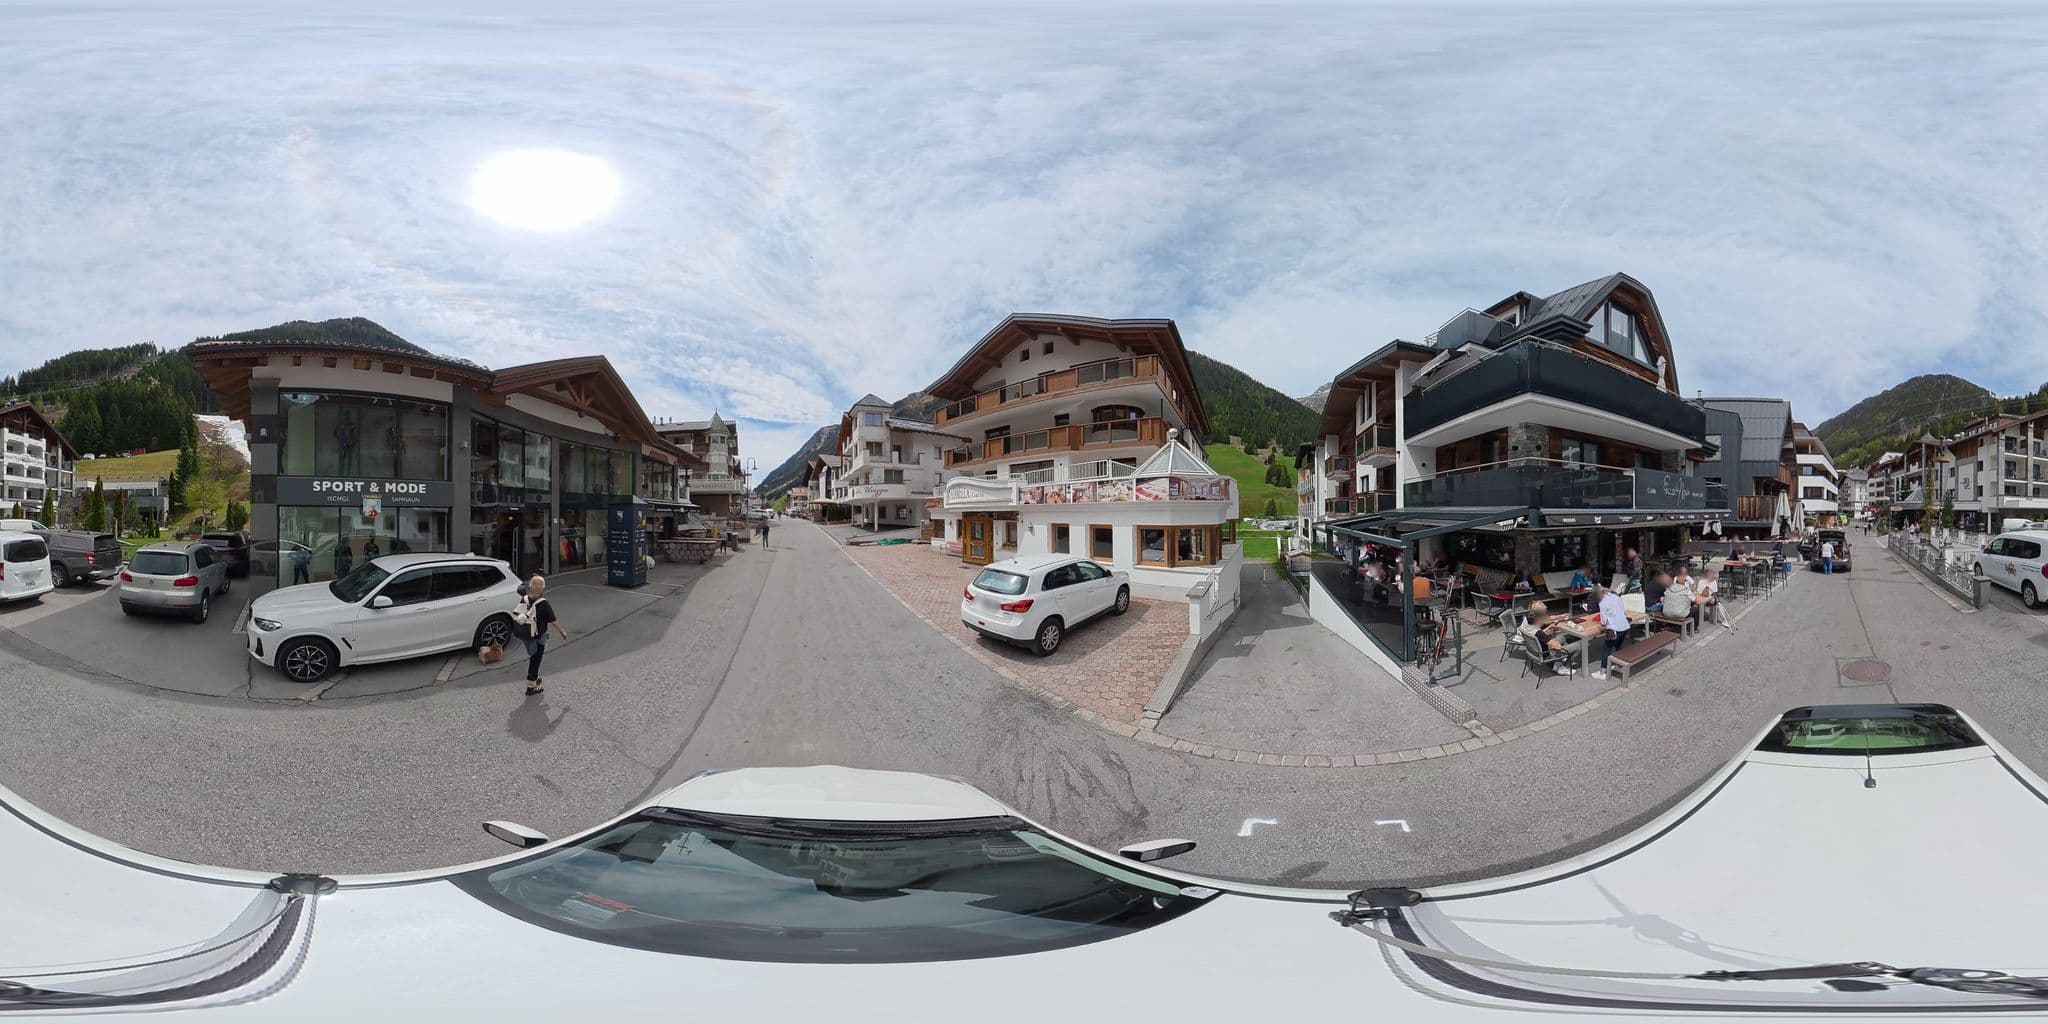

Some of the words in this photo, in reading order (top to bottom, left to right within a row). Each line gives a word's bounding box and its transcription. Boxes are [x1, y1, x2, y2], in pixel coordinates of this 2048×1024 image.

[313, 481, 364, 492] SPORT
[369, 482, 379, 493] &
[385, 483, 426, 494] MODE
